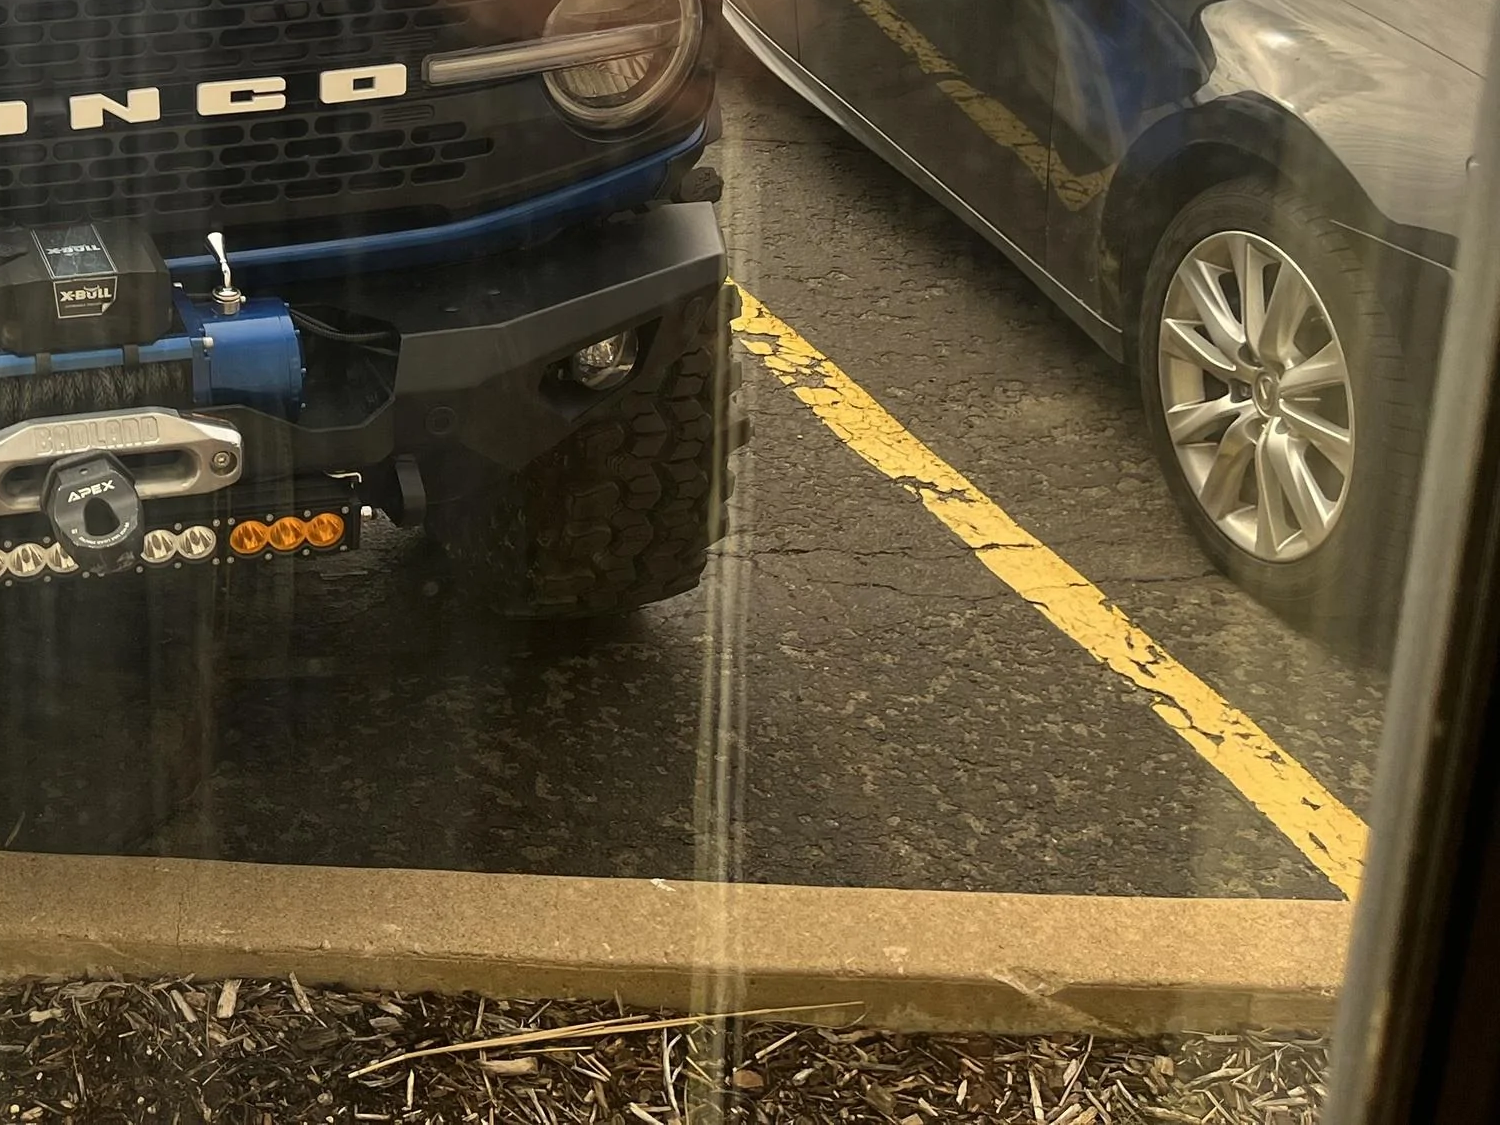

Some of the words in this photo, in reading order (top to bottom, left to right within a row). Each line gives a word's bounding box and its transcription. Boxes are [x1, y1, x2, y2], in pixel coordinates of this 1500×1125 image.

[45, 244, 101, 255] X-BULL
[60, 285, 112, 302] X-BULL
[34, 416, 160, 456] BADLAND
[67, 480, 116, 503] APEX
